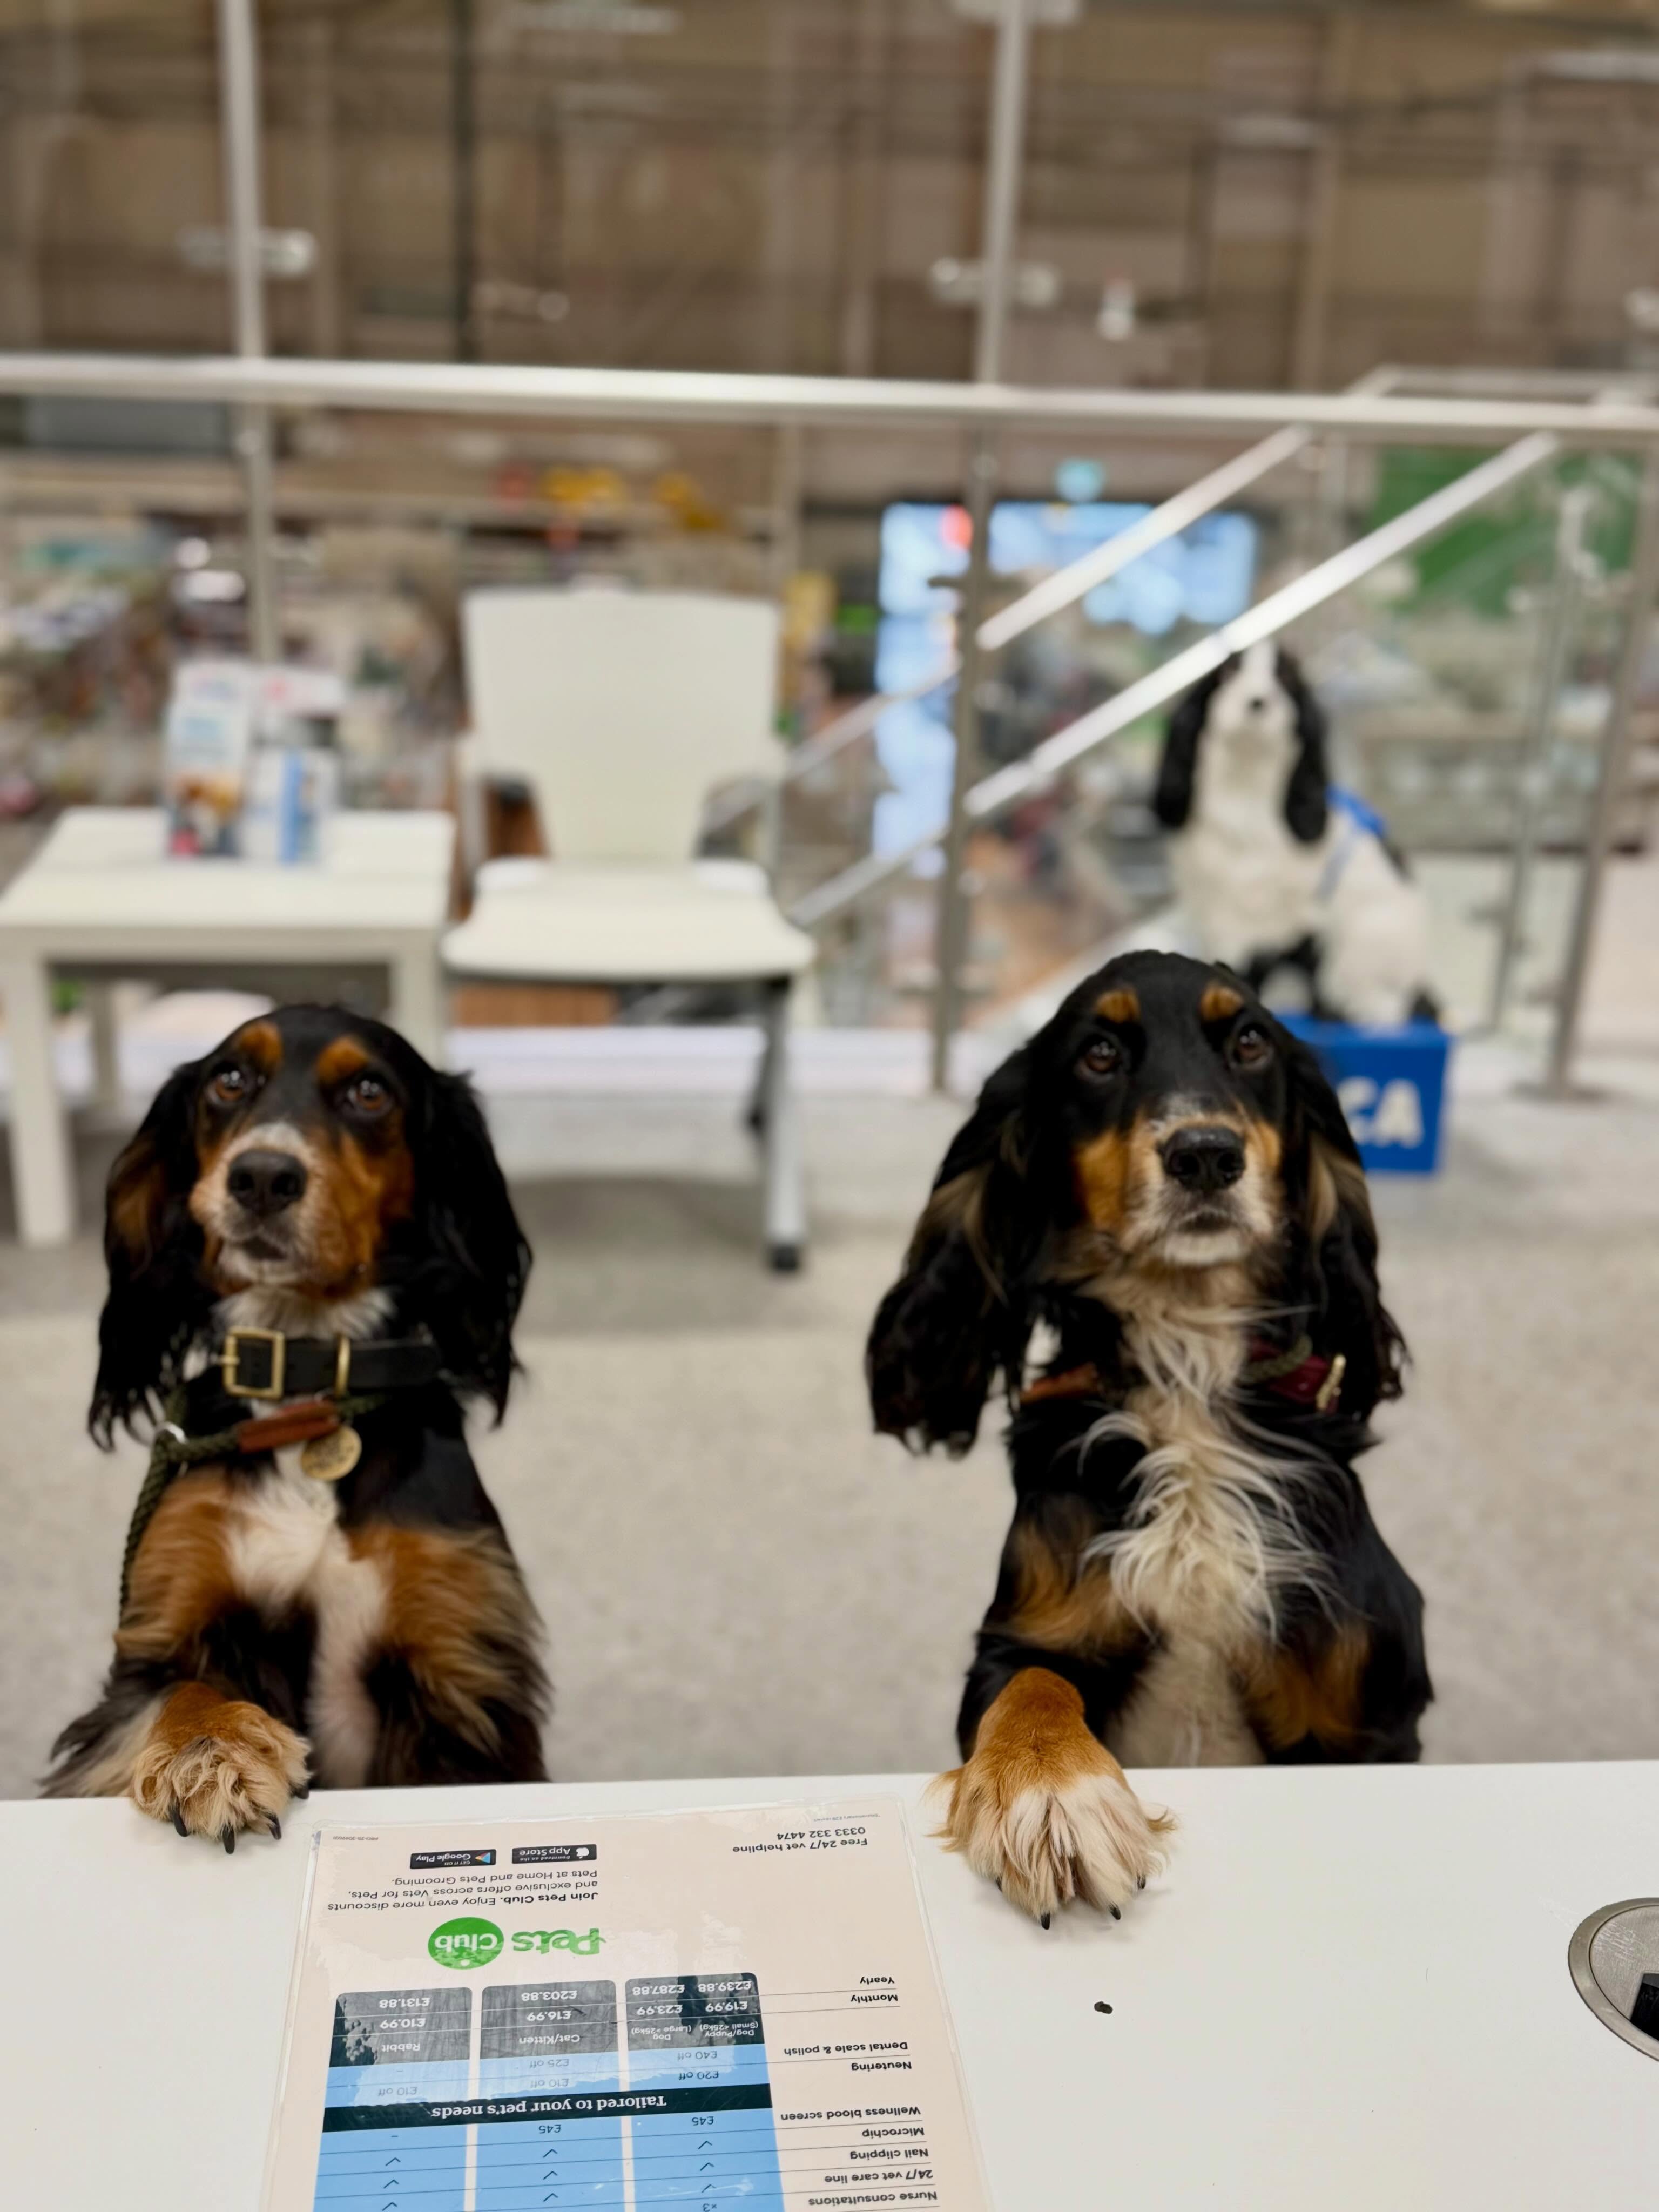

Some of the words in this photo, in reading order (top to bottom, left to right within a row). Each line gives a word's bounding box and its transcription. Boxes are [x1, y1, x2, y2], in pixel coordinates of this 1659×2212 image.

[777, 1831, 806, 1840] 4474
[809, 1829, 831, 1838] 332
[834, 1826, 866, 1837] 0333
[786, 1842, 806, 1851] vet
[809, 1839, 837, 1849] 24/7
[841, 1838, 867, 1847] Free
[548, 1847, 570, 1856] App
[732, 1843, 783, 1854] helpline
[490, 1874, 513, 1883] and
[516, 1872, 552, 1880] Home
[572, 1870, 597, 1878] Pets
[392, 1877, 456, 1886] Grooming.
[575, 1881, 598, 1889] and
[477, 1885, 511, 1893] offers
[516, 1883, 571, 1891] exclusive
[382, 1891, 399, 1899] for
[403, 1890, 428, 1898] Vets
[570, 1892, 598, 1901] Join
[462, 1897, 495, 1906] Enjoy
[500, 1896, 534, 1904] Club.
[328, 1903, 389, 1911] discounts
[435, 1933, 498, 1952] Club
[511, 1928, 604, 1955] Pets
[860, 1977, 894, 1985] Yearly
[632, 1984, 685, 1995] £287.88
[698, 1981, 752, 1992] £239.88
[521, 1990, 577, 2001] £203.88
[851, 1995, 898, 2003] Monthly
[380, 1997, 430, 2007] £131.88
[705, 2001, 747, 2012] £19.99
[637, 2004, 683, 2015] £23.99
[527, 2010, 571, 2021] £16.99
[380, 2018, 426, 2028] £10.99
[732, 2021, 758, 2029] (Small
[705, 2029, 754, 2038] Dog/Puppy
[518, 2034, 579, 2045] Cat/Kitten
[381, 2043, 420, 2052] Rabbit
[784, 2045, 819, 2056] polish
[835, 2044, 866, 2053] scale
[870, 2041, 908, 2052] Dental
[677, 2052, 691, 2061] off
[695, 2051, 717, 2060] £40
[529, 2060, 544, 2069] off
[548, 2059, 569, 2068] £25
[851, 2061, 912, 2072] Neutering
[678, 2072, 693, 2080] off
[697, 2071, 719, 2079] £20
[530, 2080, 545, 2088] off
[549, 2078, 569, 2087] £10
[377, 2088, 393, 2096] off
[396, 2086, 417, 2095] £10
[531, 2099, 571, 2113] your
[576, 2100, 593, 2110] to
[596, 2095, 666, 2110] Tailored
[431, 2105, 483, 2119] needs
[487, 2101, 527, 2116] pet's
[865, 2106, 921, 2118] Wellness
[780, 2112, 822, 2122] screen
[826, 2109, 862, 2120] blood
[692, 2116, 714, 2126] £45
[539, 2125, 561, 2134] £45
[862, 2127, 924, 2139] Microchip
[850, 2149, 901, 2161] clipping
[904, 2148, 928, 2159] Nail
[851, 2173, 879, 2183] care
[882, 2171, 902, 2182] vet
[906, 2169, 933, 2180] 24/7
[825, 2175, 848, 2185] line
[808, 2194, 895, 2207] consultations
[900, 2190, 937, 2202] Nurse
